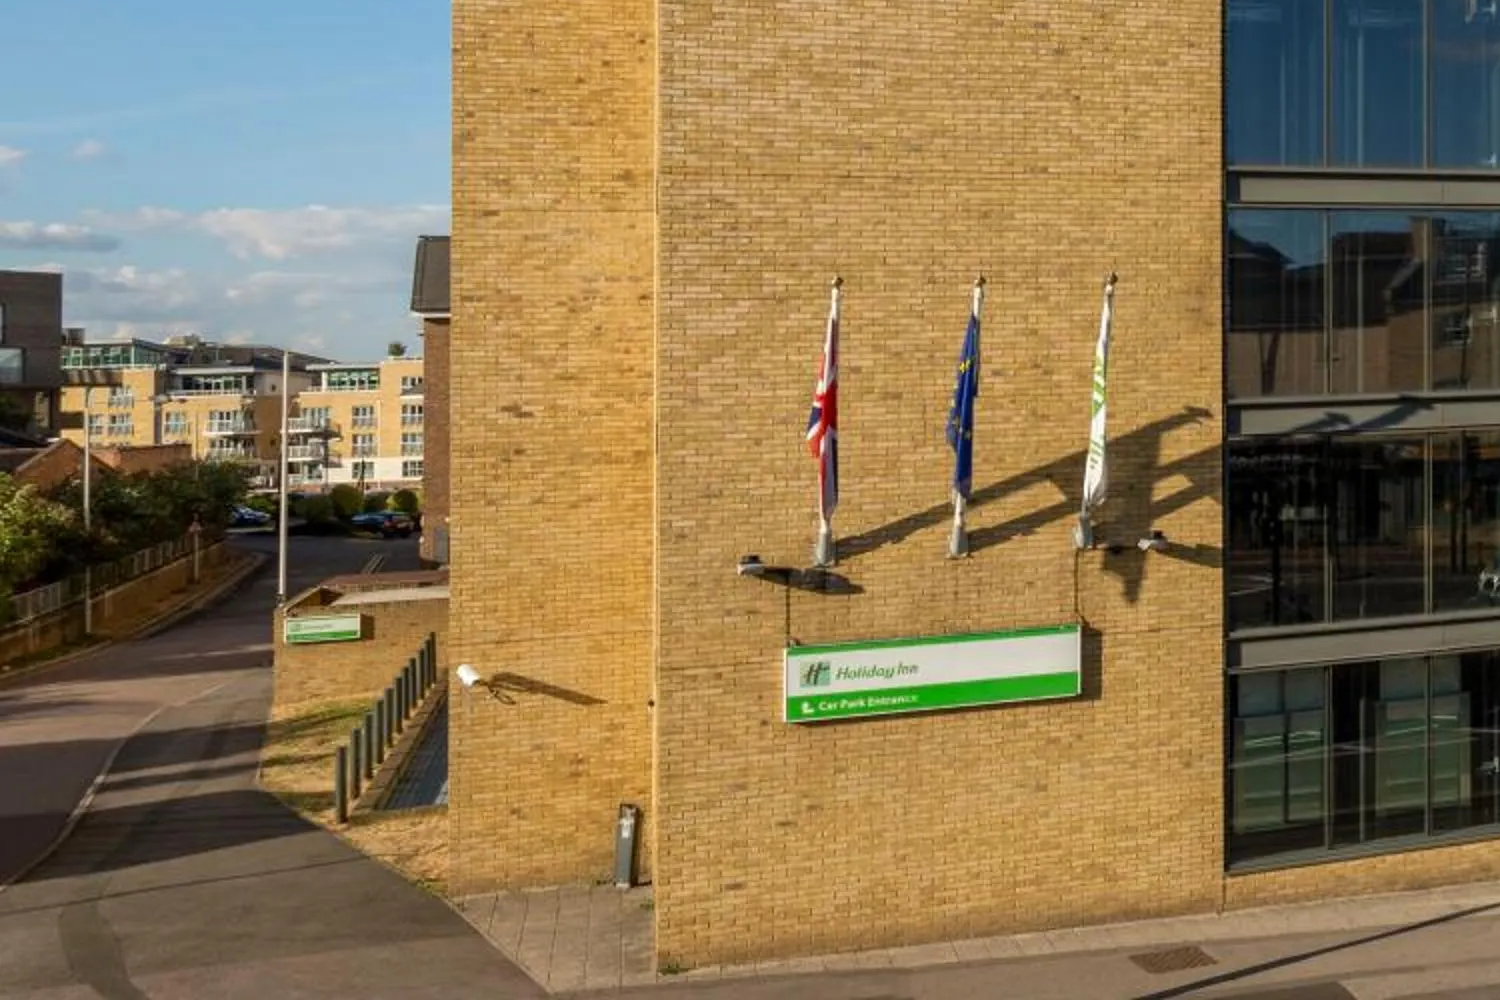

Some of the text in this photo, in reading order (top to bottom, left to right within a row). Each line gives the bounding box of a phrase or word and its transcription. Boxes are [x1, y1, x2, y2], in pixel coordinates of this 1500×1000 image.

[836, 661, 918, 679] Holiday Inn
[818, 695, 918, 711] Car Park Entrance
